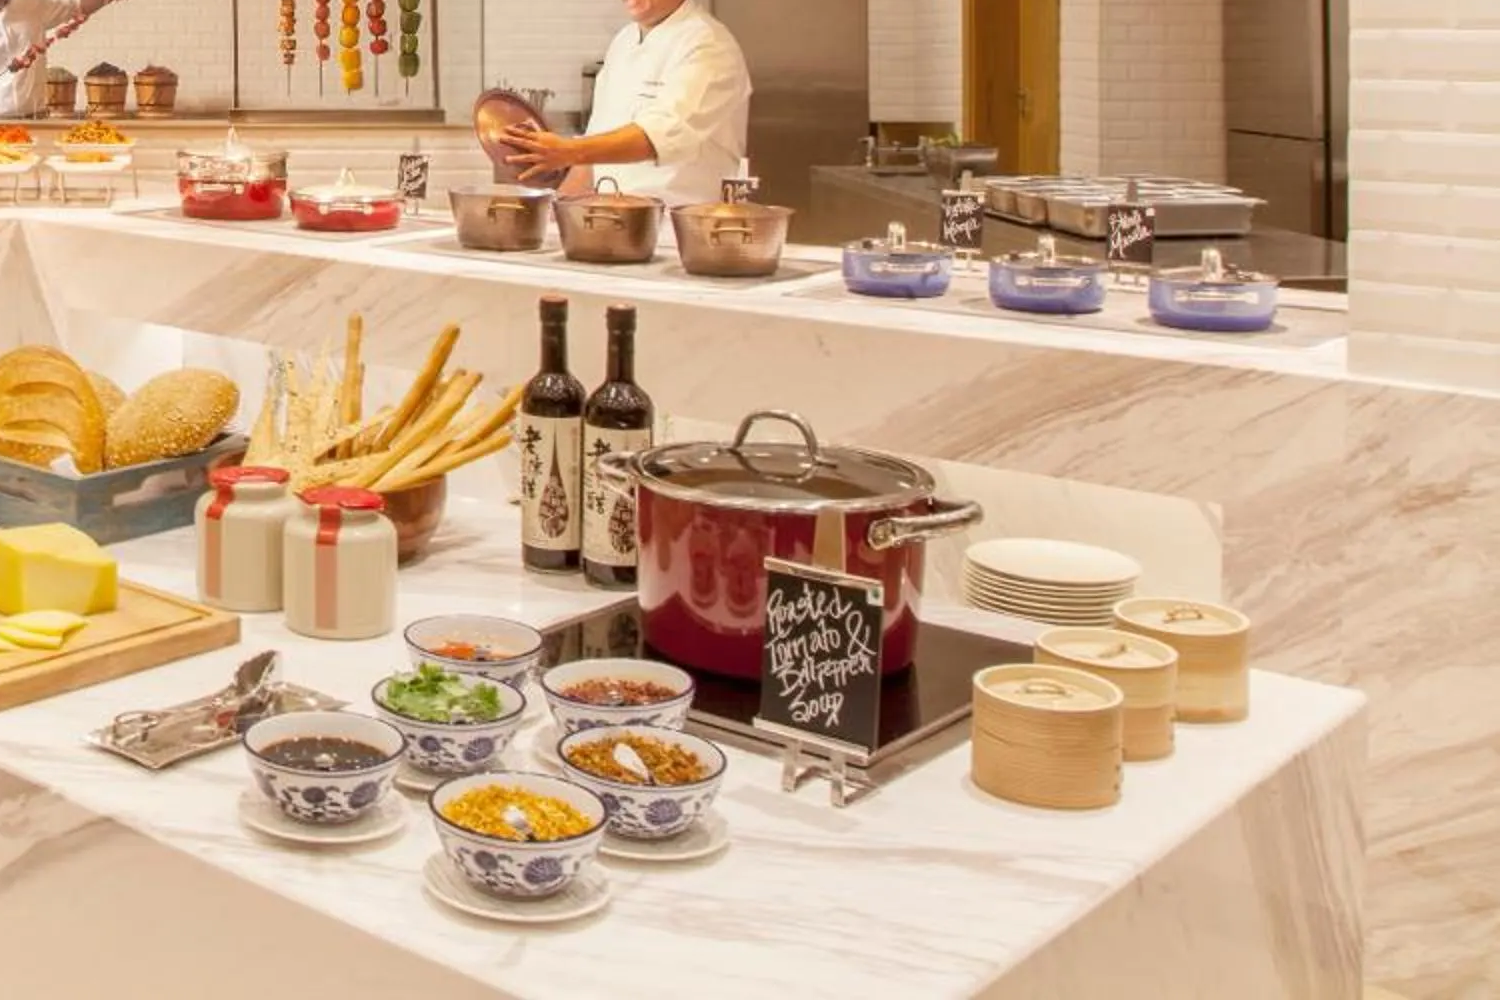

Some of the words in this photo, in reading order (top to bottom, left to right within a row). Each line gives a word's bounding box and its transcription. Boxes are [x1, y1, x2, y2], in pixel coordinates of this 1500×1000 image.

[766, 581, 853, 638] Roasted
[764, 618, 841, 674] Tomato
[845, 610, 877, 660] &
[788, 686, 845, 728] Soup
